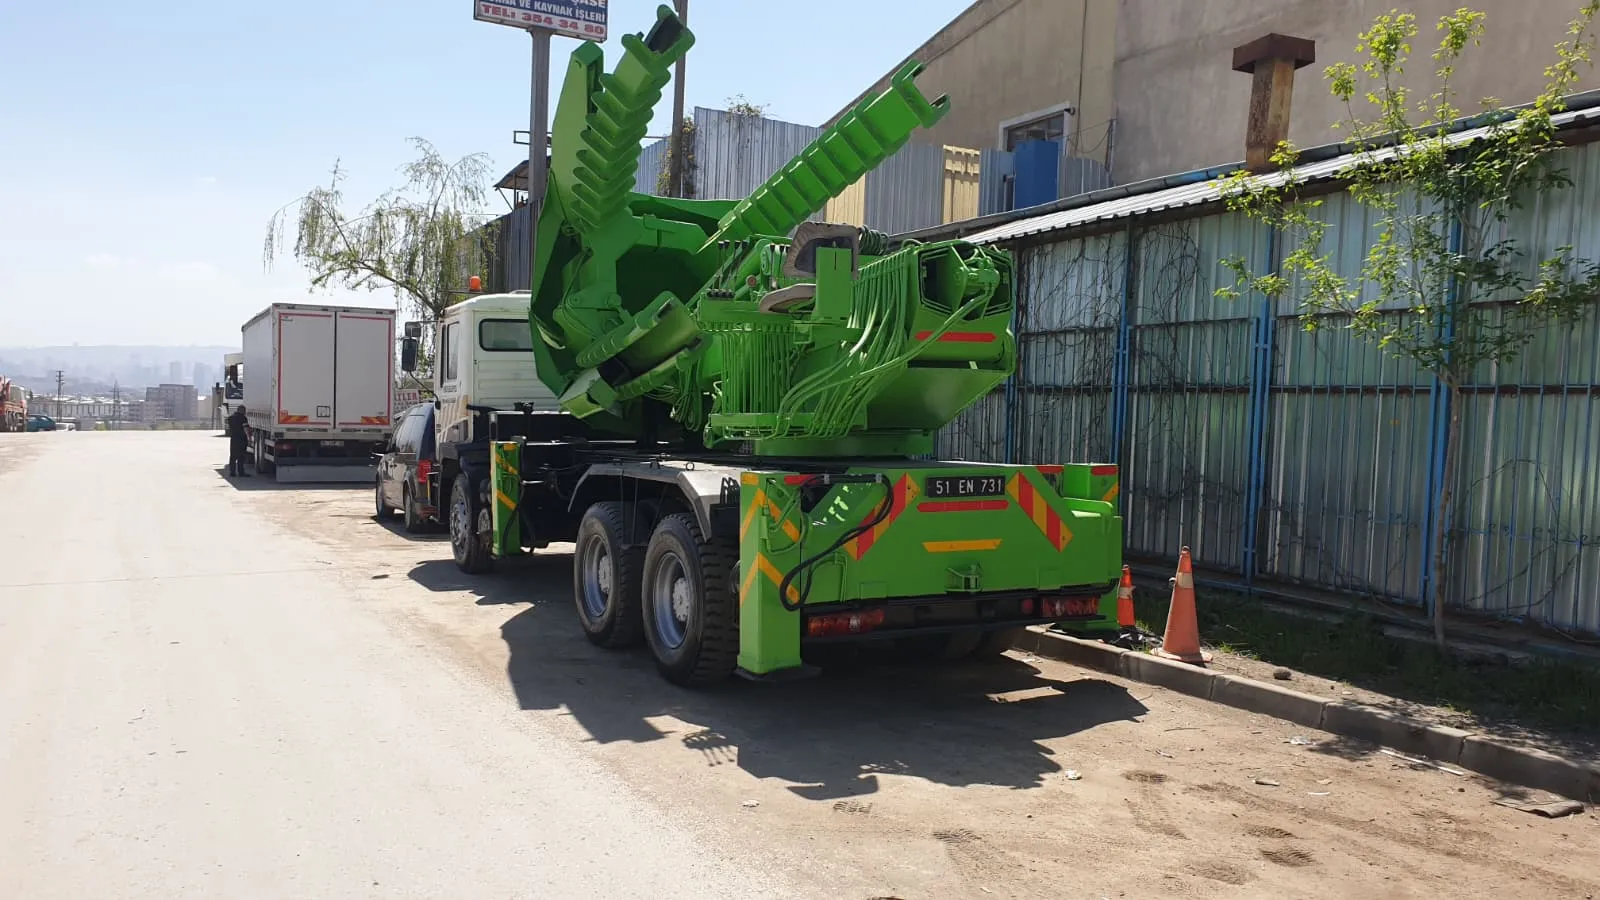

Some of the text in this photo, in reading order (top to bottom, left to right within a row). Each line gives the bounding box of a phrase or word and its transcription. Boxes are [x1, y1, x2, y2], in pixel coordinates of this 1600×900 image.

[519, 0, 530, 8] VE
[534, 1, 573, 16] KAYNAK
[481, 4, 516, 18] TEL:
[521, 12, 553, 25] 354
[558, 19, 578, 30] 34
[936, 479, 1001, 494] 51 EN 731
